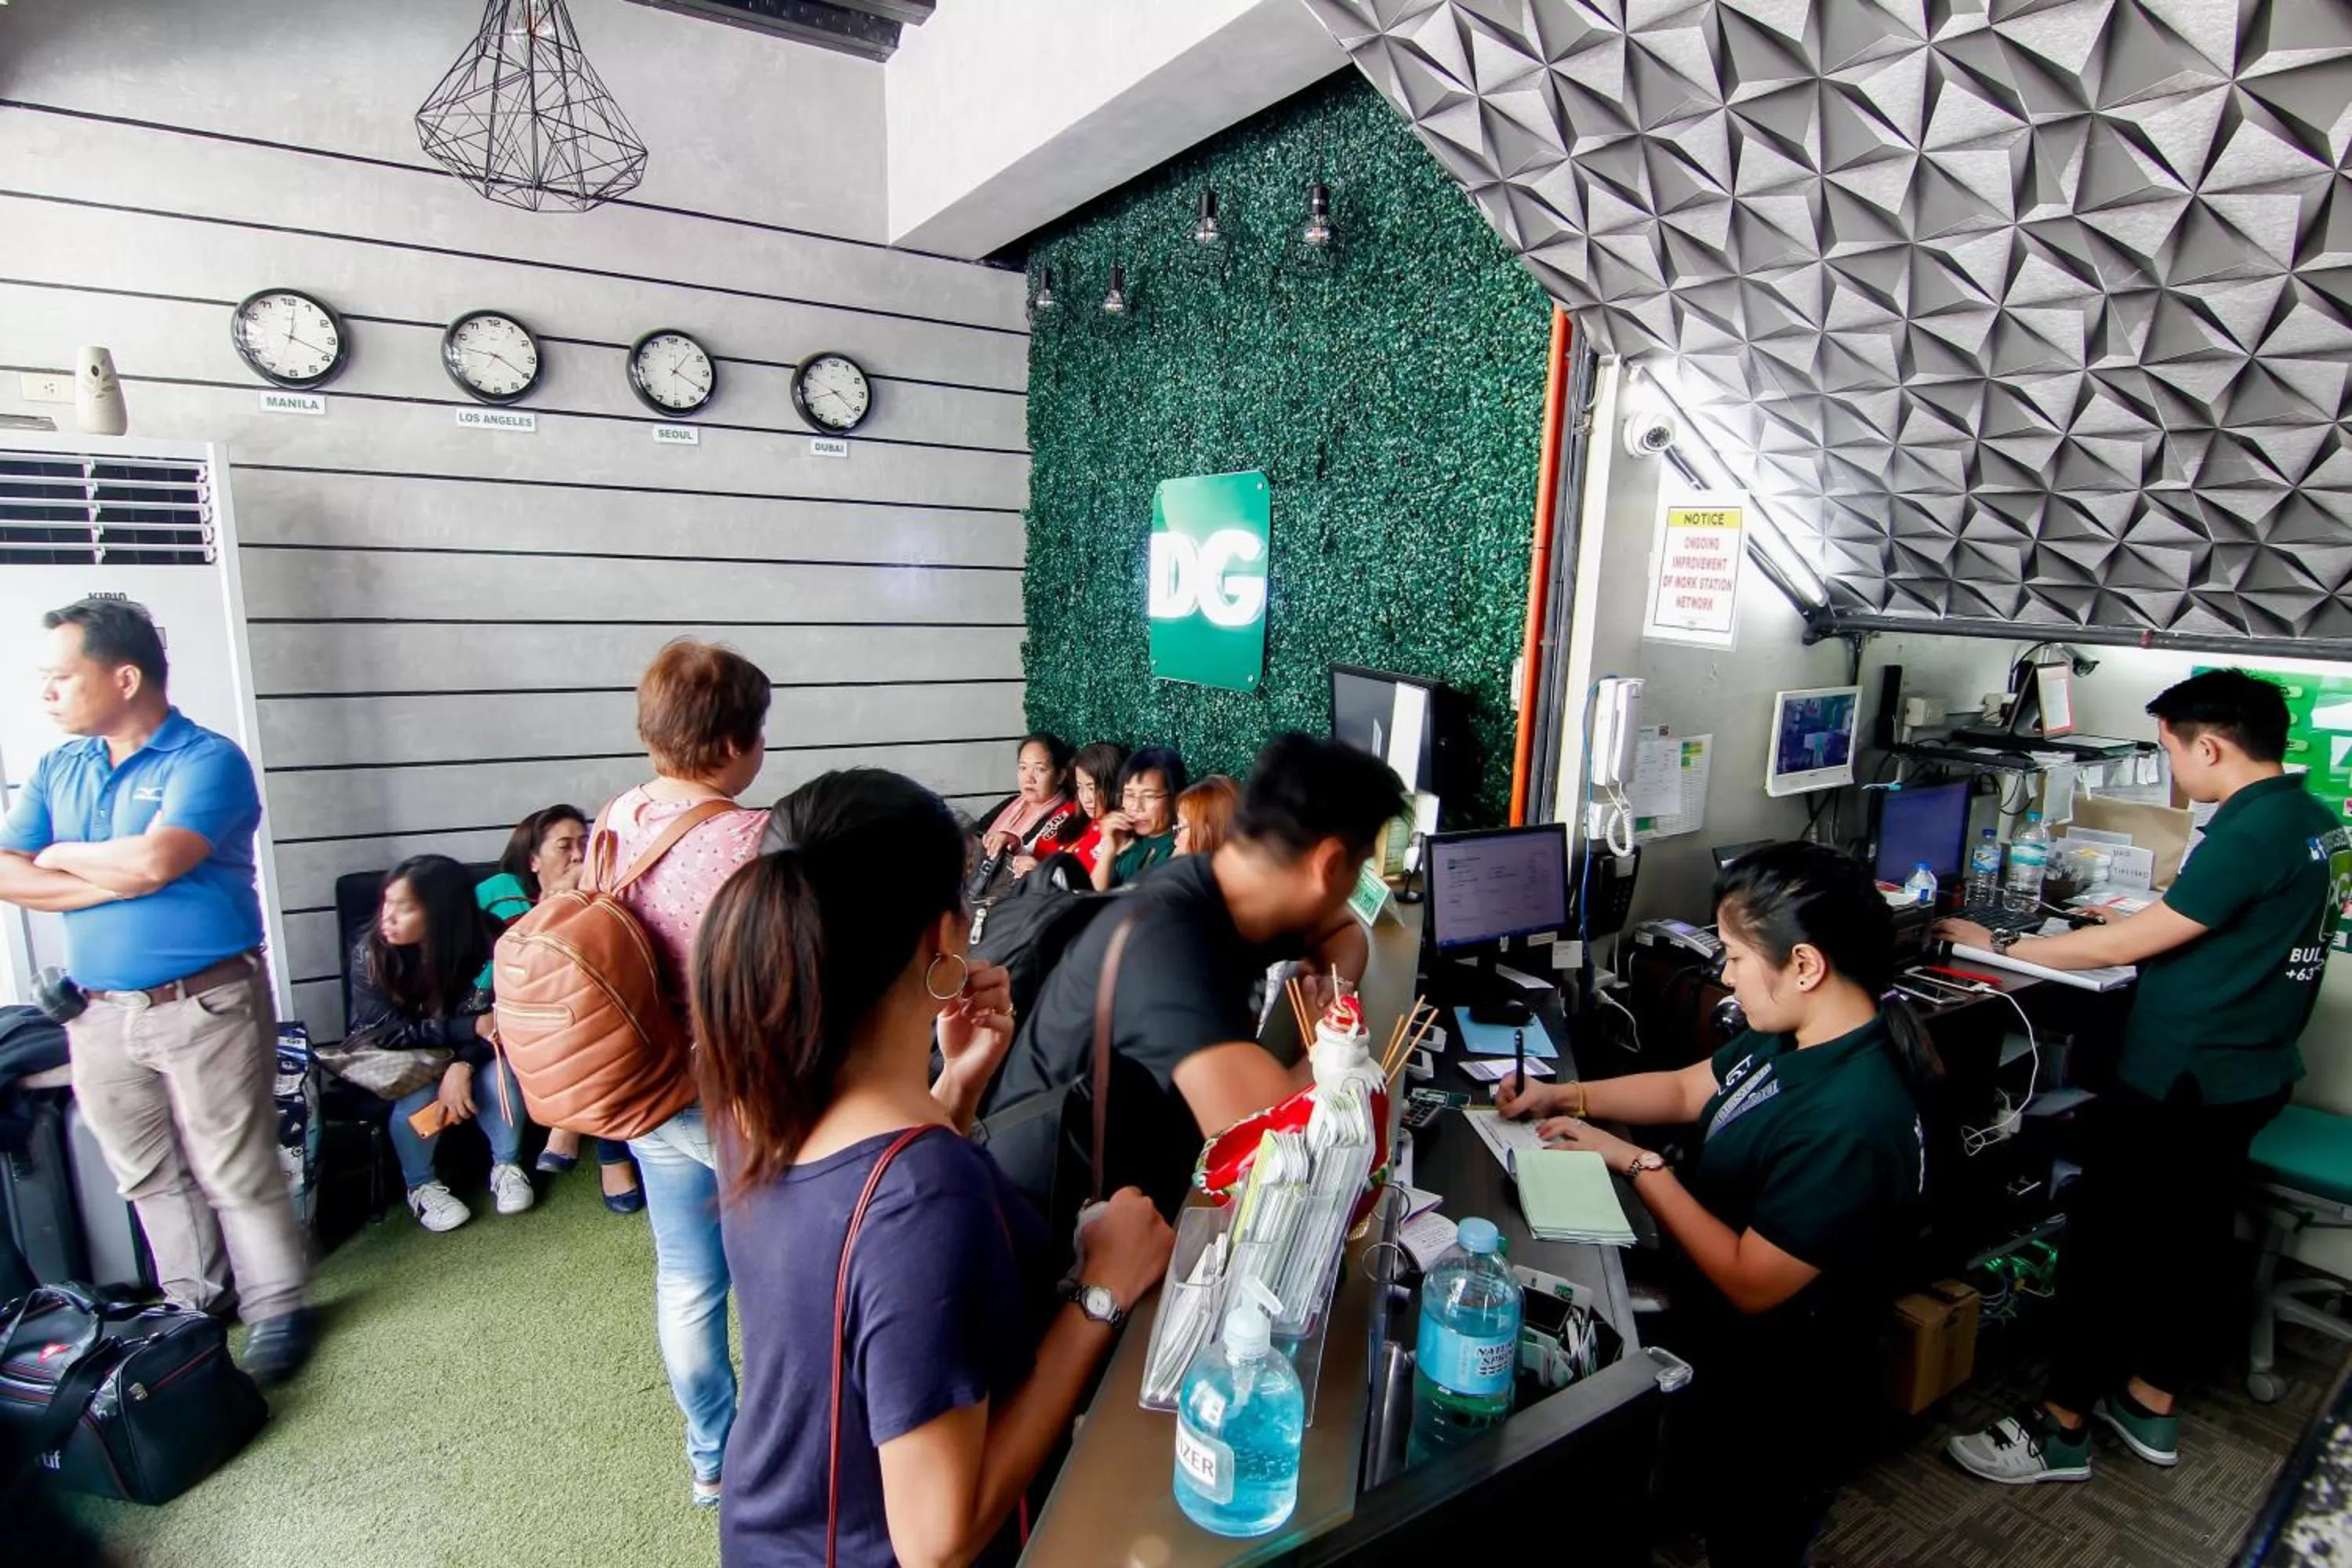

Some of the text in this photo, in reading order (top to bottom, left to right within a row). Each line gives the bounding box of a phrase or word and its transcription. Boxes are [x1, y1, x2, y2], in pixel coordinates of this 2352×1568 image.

[259, 300, 272, 309] 11
[281, 298, 296, 307] 12
[304, 303, 312, 312] 1
[320, 319, 329, 328] 2
[327, 336, 336, 346] 3
[321, 354, 332, 362] 4
[527, 356, 535, 365] 3
[266, 395, 320, 410] MANILA
[459, 412, 532, 427] LOS ANGELES
[657, 429, 694, 440] SEOUL
[815, 442, 845, 452] DUBAI
[1683, 514, 1726, 526] NOTICE
[1684, 536, 1720, 550] ONGOING
[1672, 556, 1729, 571] IMPROVEMENT
[1149, 529, 1265, 627] DG
[1662, 575, 1733, 592] OF WORK STATION
[1675, 595, 1714, 612] NETWORK
[1178, 1436, 1214, 1478] IZER
